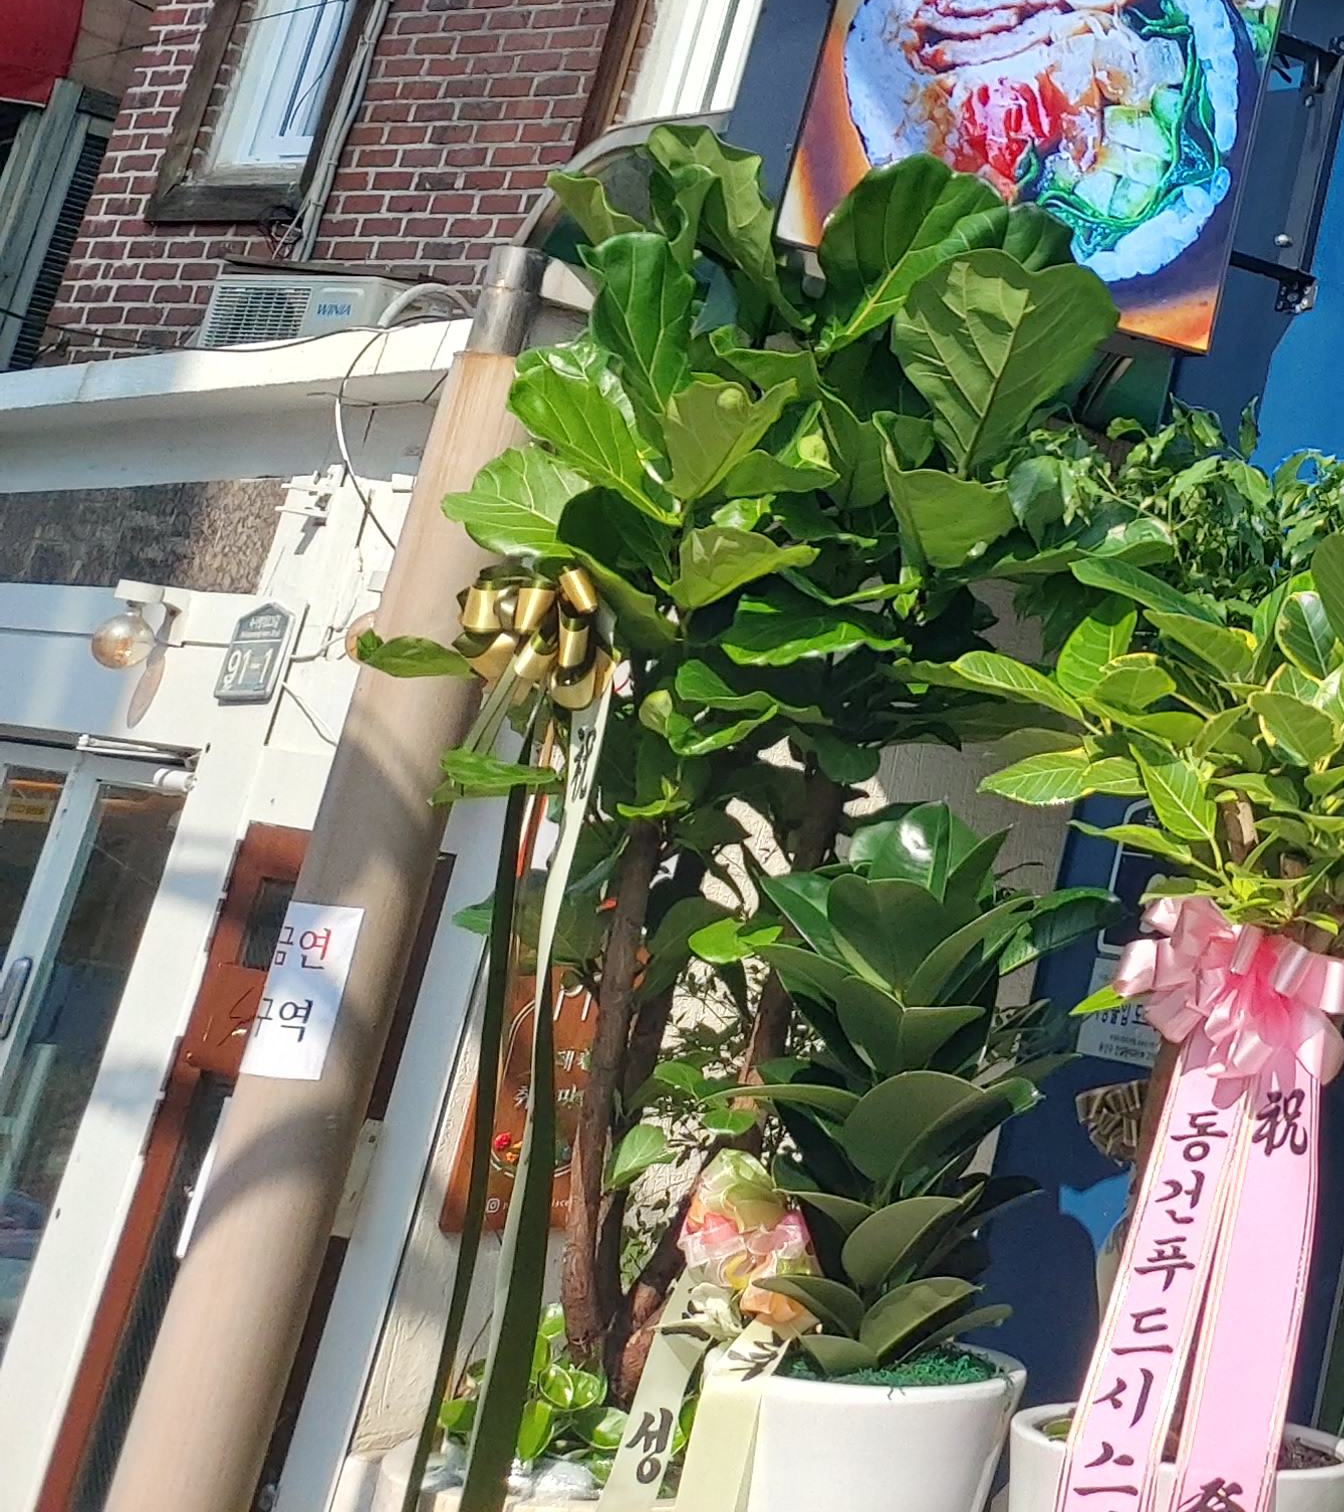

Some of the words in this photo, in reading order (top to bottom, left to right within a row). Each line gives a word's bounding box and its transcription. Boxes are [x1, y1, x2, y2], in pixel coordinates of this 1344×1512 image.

[223, 648, 274, 687] 91-1
[274, 926, 332, 970] 금연
[255, 998, 314, 1043] 구역
[1073, 1110, 1229, 1512] 동건푸드시스
